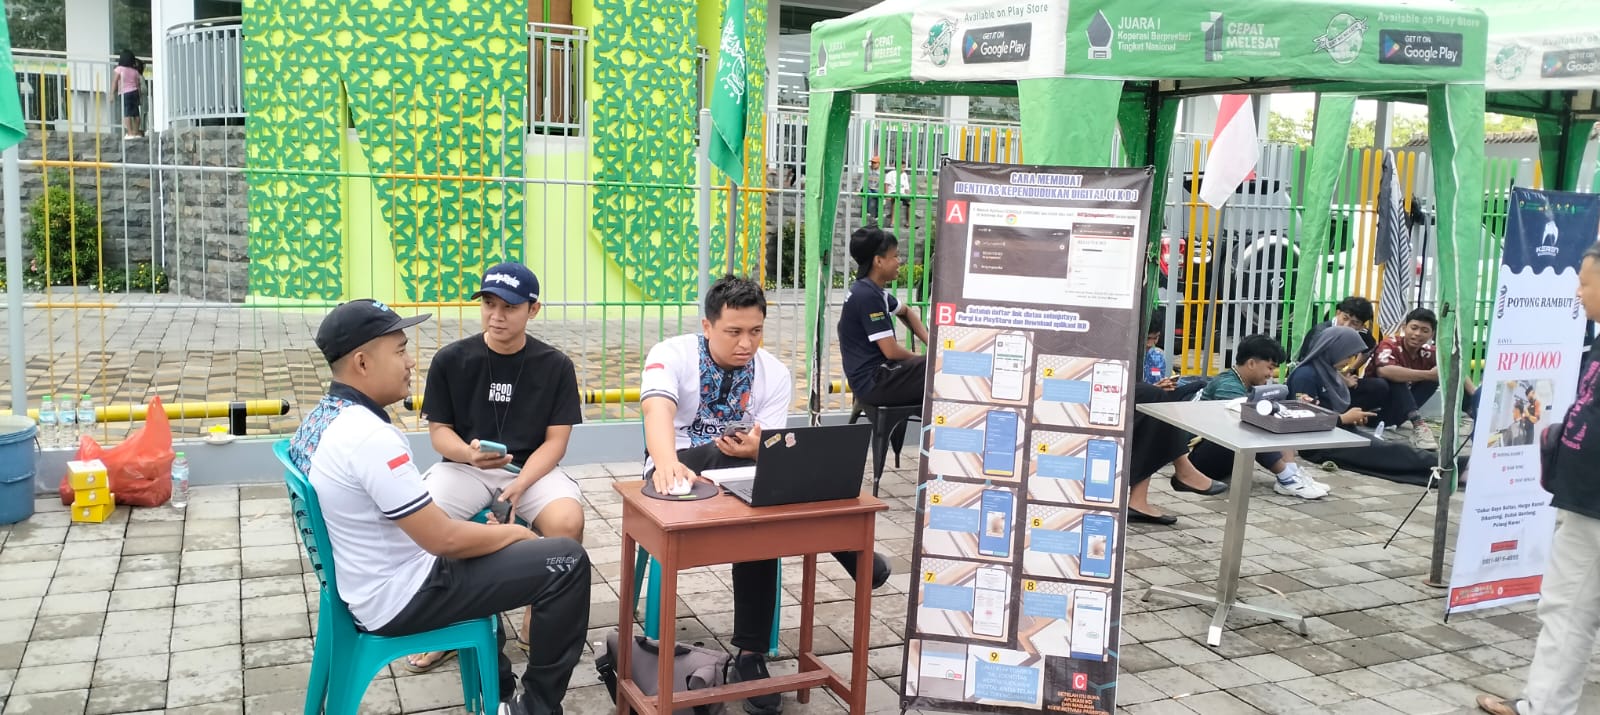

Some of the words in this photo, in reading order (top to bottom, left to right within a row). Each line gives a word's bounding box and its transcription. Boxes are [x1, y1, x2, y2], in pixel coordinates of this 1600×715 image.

[964, 10, 994, 22] Available
[997, 9, 1006, 18] on
[1008, 6, 1024, 17] Play
[1026, 3, 1048, 14] Store
[1378, 12, 1419, 24] Available
[1422, 16, 1434, 24] on
[1436, 15, 1456, 28] Play
[1457, 17, 1480, 28] Store
[1118, 16, 1155, 30] JUARA
[1227, 22, 1265, 36] CEPAT
[1226, 36, 1281, 49] MELESAT
[1404, 35, 1416, 43] GET
[980, 41, 1008, 58] Google
[1009, 40, 1027, 57] Play
[1404, 45, 1438, 62] Google
[1439, 46, 1458, 63] Play
[1011, 172, 1035, 184] CARA
[1037, 174, 1082, 187] MEMBUAT
[955, 182, 999, 194] IDENTITAS
[1001, 186, 1070, 199] KEPENDUDUKAN
[1071, 189, 1105, 200] DIGITAL
[948, 204, 964, 222] A
[1507, 297, 1540, 308] POTONG
[1541, 297, 1574, 308] RAMBUT
[939, 306, 952, 324] B
[1496, 352, 1519, 371] RP
[1520, 351, 1562, 370] 10.000
[490, 382, 512, 396] GOOD
[1074, 674, 1084, 689] C
